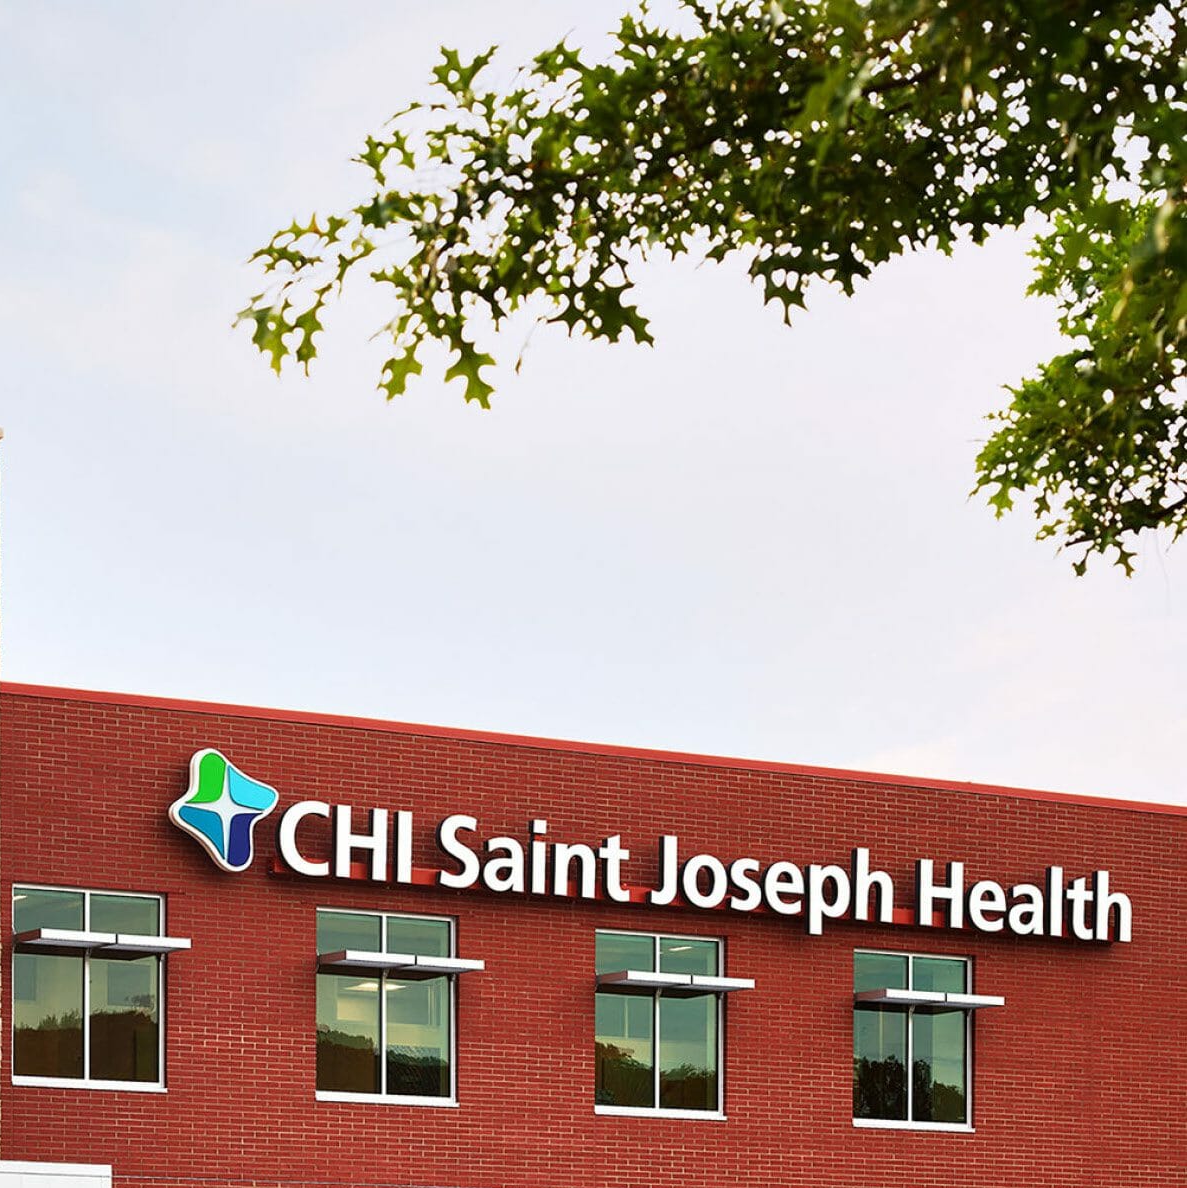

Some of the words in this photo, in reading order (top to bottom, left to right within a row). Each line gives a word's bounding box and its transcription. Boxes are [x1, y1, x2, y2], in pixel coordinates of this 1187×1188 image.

[279, 800, 414, 884] CHI
[439, 814, 631, 903] Saint
[649, 835, 895, 936] Joseph
[919, 858, 1133, 943] Health
